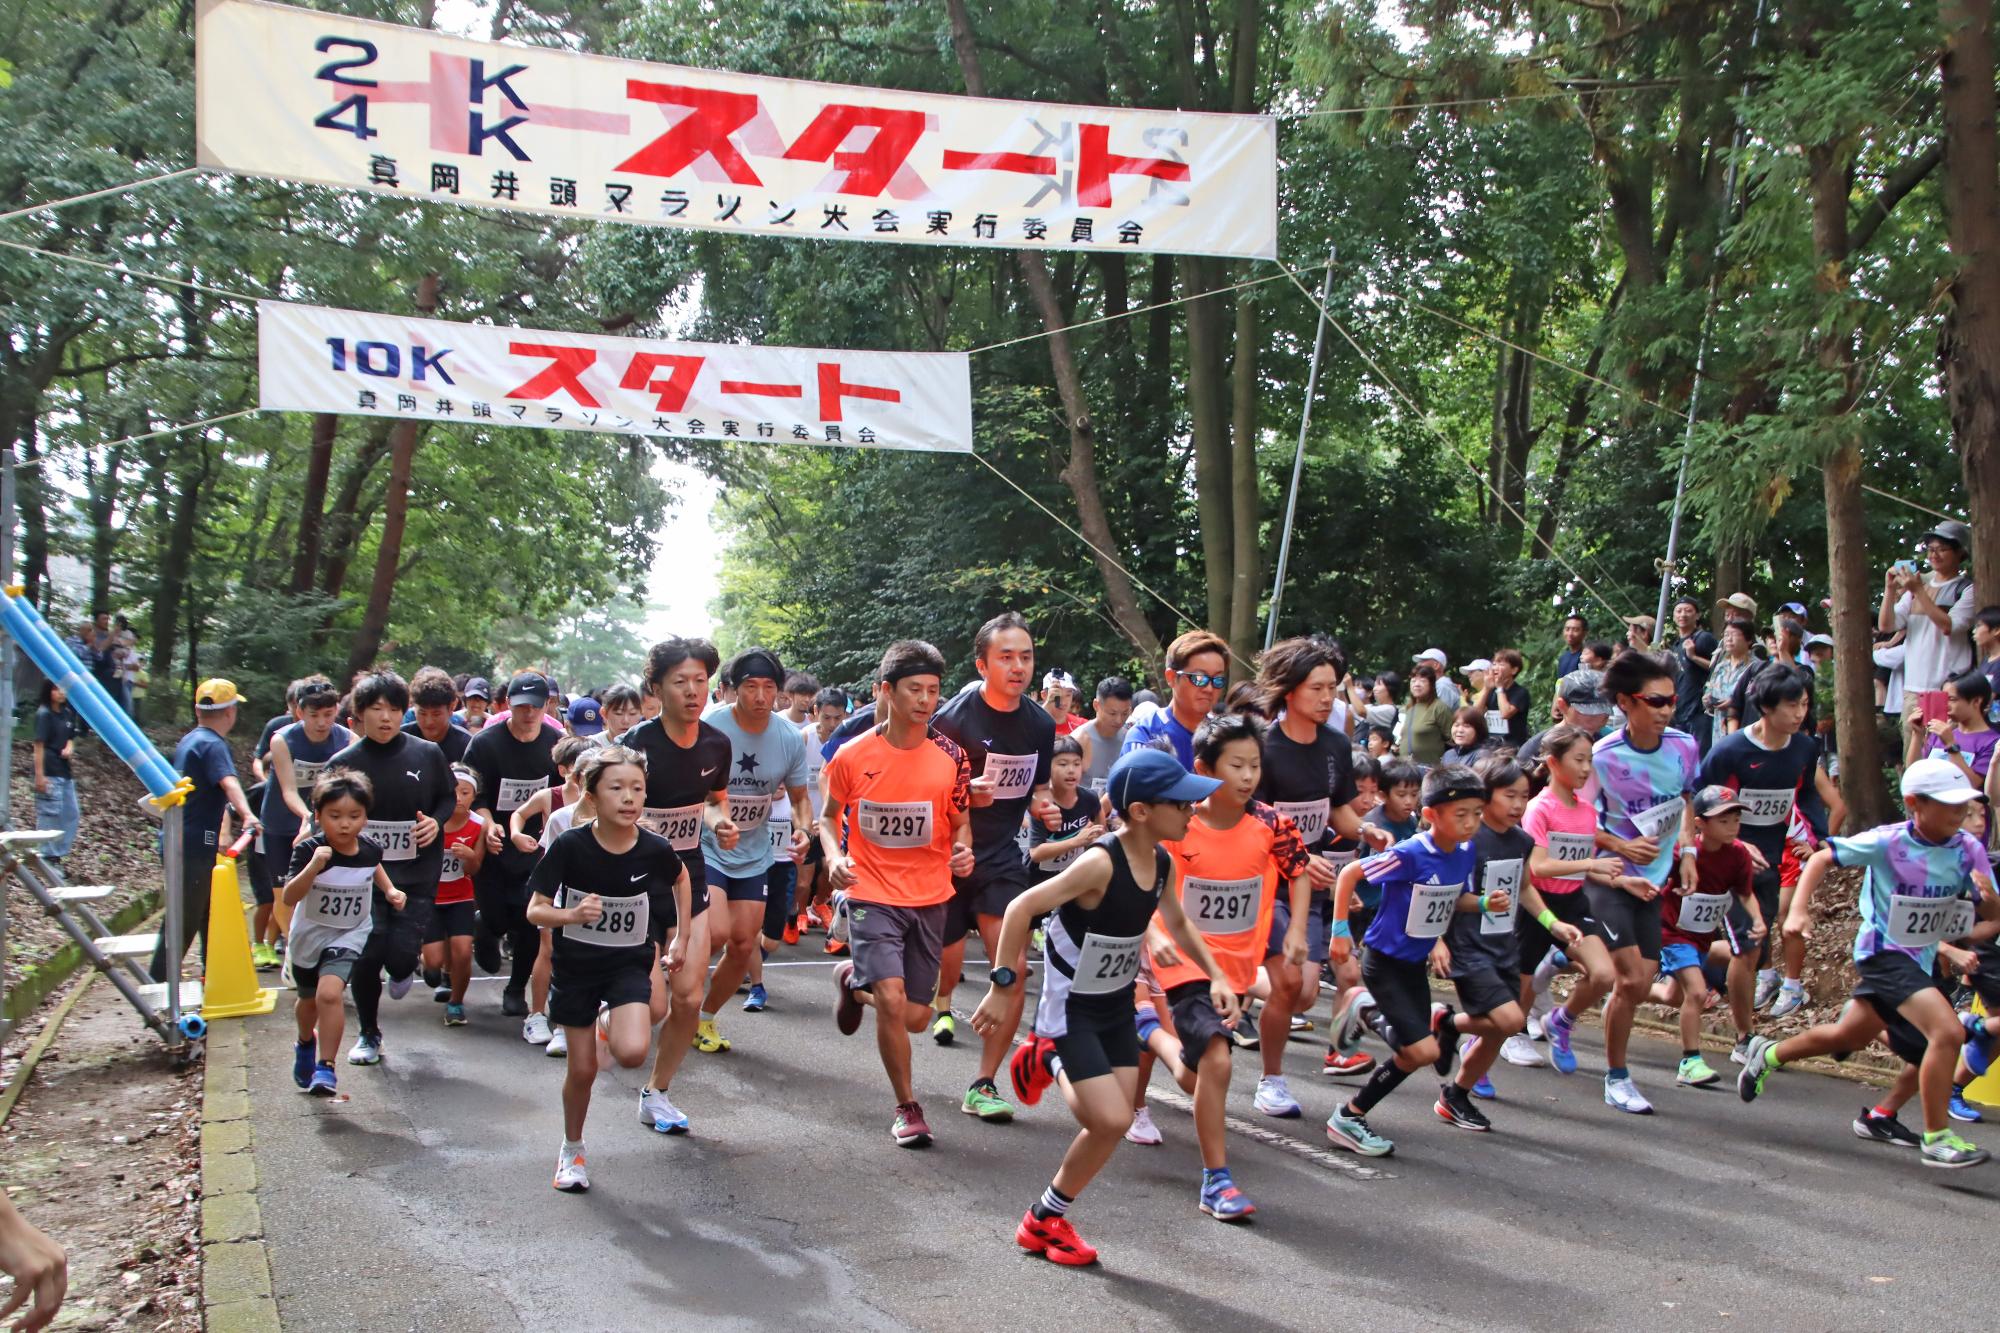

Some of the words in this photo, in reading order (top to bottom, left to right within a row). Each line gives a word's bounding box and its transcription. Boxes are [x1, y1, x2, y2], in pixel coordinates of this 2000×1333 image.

[613, 79, 1191, 208] スタート
[368, 153, 1144, 245] 真岡井頭マラソン大会実行委員会
[326, 337, 456, 386] 10K
[504, 342, 900, 422] スタート
[358, 389, 876, 443] 真岡井頭マラソン大会実行委員会
[998, 768, 1031, 787] 2280
[514, 786, 545, 802] 23
[731, 805, 765, 821] 2264
[1753, 800, 1788, 816] 2256
[660, 818, 697, 839] 2289
[880, 816, 926, 836] 2297
[1057, 816, 1088, 831] IKE
[319, 895, 362, 917] 2375
[1200, 893, 1251, 920] 2297
[1946, 914, 1968, 934] 54
[1096, 951, 1138, 978] 226
